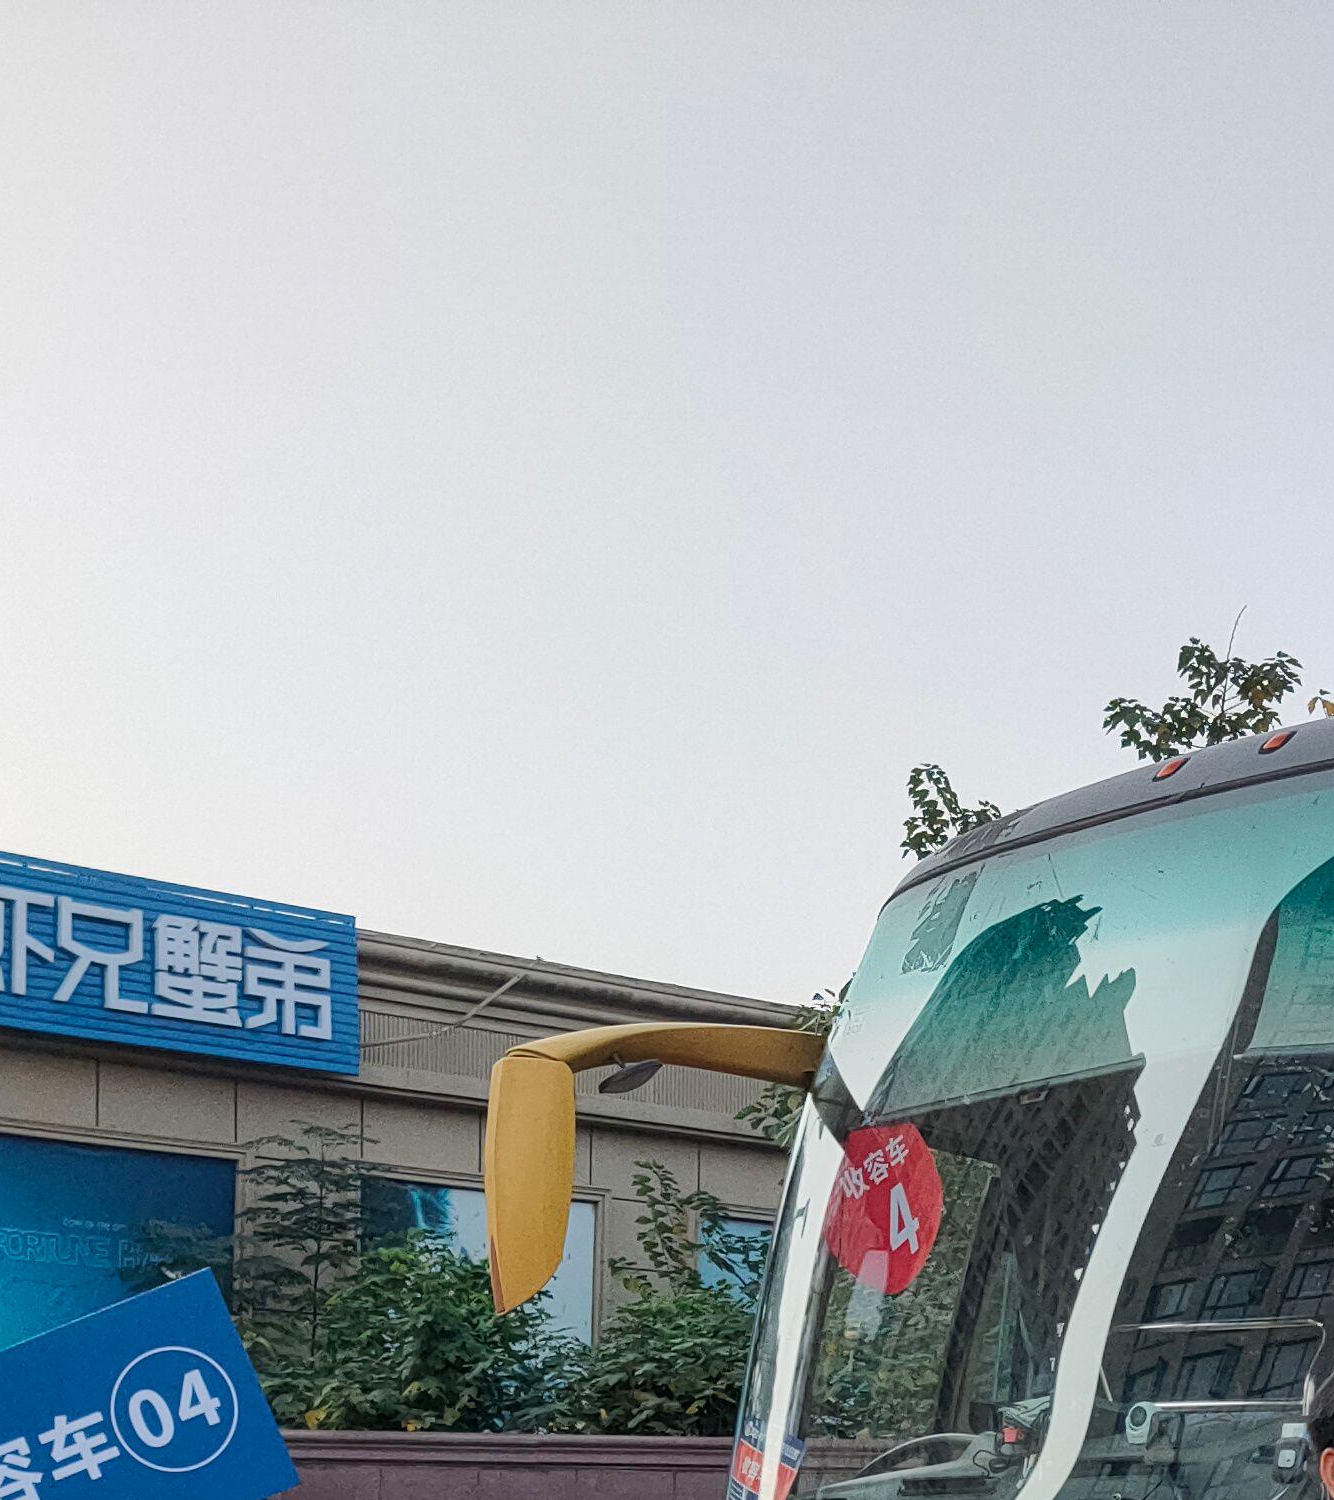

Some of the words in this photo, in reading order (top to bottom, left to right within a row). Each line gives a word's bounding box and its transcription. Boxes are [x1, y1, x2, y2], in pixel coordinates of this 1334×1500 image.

[839, 1134, 910, 1201] 收容车
[889, 1182, 920, 1254] 4
[127, 1369, 222, 1449] 04
